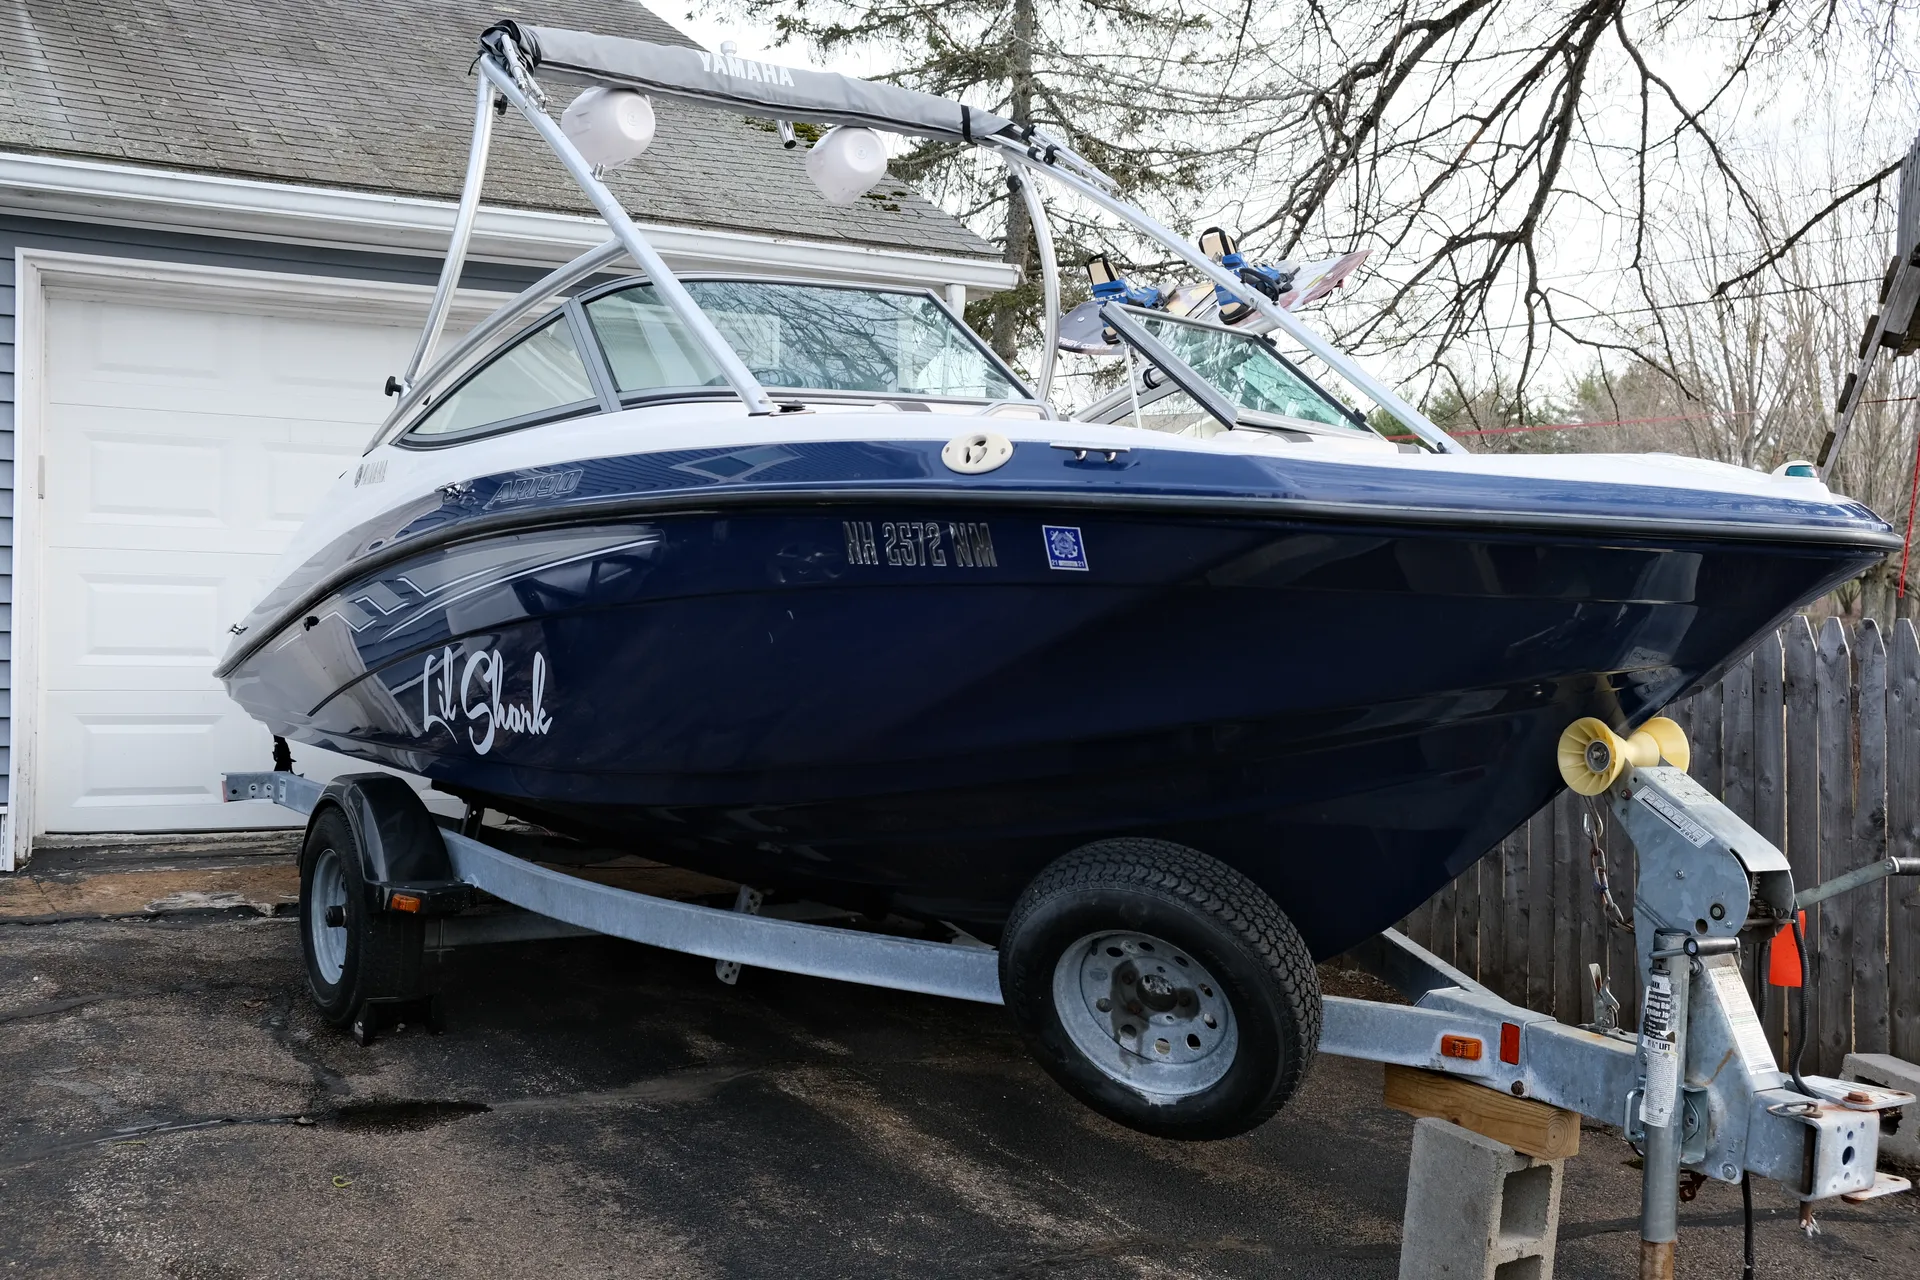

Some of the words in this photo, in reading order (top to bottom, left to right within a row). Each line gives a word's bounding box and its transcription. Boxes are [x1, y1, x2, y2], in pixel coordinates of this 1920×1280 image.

[697, 50, 795, 87] YAMAHA
[489, 467, 585, 505] AR190
[842, 521, 879, 566] NH
[881, 522, 947, 567] 2572
[948, 522, 998, 568] NM
[423, 645, 459, 745] Lil
[459, 648, 553, 756] Shark
[1643, 791, 1706, 840] PROFILE
[1658, 1042, 1671, 1051] LIFT
